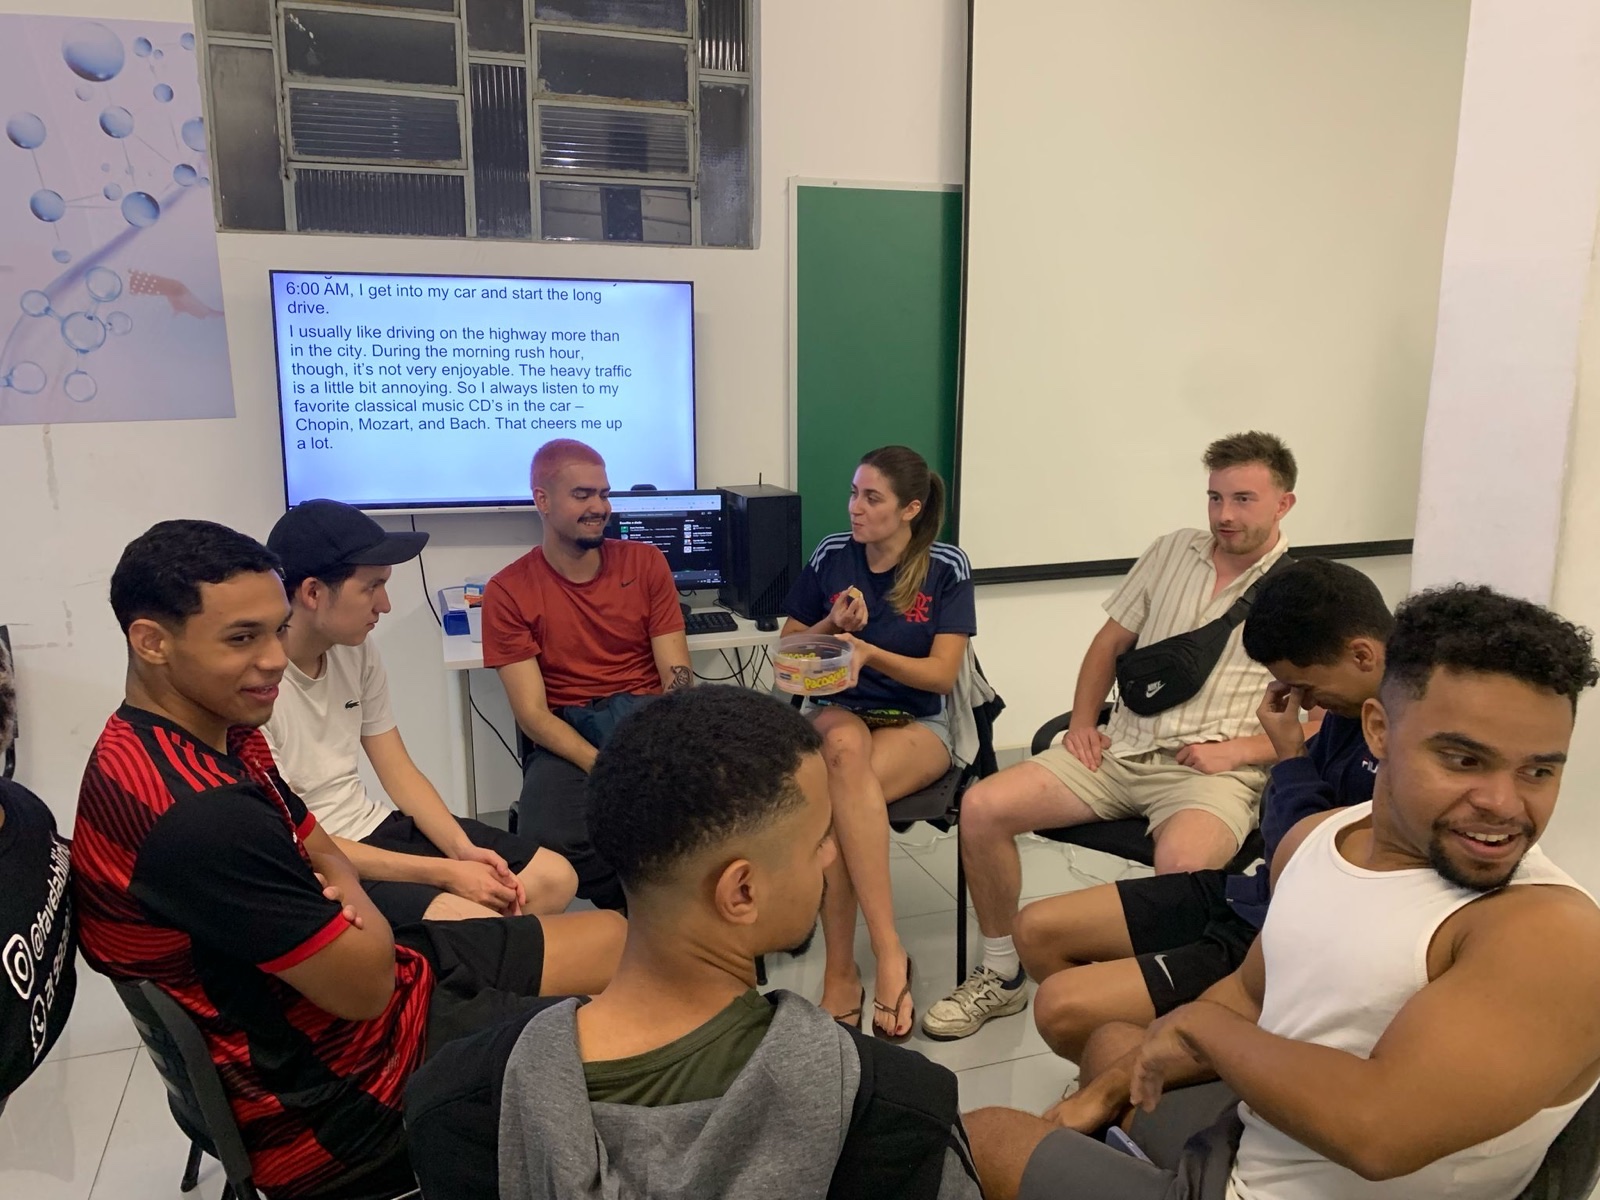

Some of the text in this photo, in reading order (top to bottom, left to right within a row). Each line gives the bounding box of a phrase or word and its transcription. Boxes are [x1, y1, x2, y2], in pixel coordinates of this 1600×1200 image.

[286, 281, 601, 304] 6:00 AM, I get into my car and start the long
[288, 301, 329, 314] drive.
[289, 324, 619, 343] I usually like driving on the highway more than
[291, 344, 583, 361] in the city. During the morning rush hour,
[292, 363, 348, 378] though,
[379, 364, 402, 375] not
[406, 366, 437, 379] very
[442, 363, 514, 379] enjoyable.
[519, 364, 545, 376] The
[550, 364, 591, 380] heavy
[595, 365, 632, 377] traffic
[293, 380, 619, 397] is a little bit annoying. So I always listen to my
[294, 399, 349, 412] favorite
[355, 399, 416, 412] classical
[422, 399, 464, 412] music
[508, 400, 519, 411] in
[524, 400, 545, 411] the
[550, 402, 571, 412] car
[296, 417, 622, 433] Chopin, Mozart, and Bach. That cheers me up
[297, 437, 333, 449] a lot.
